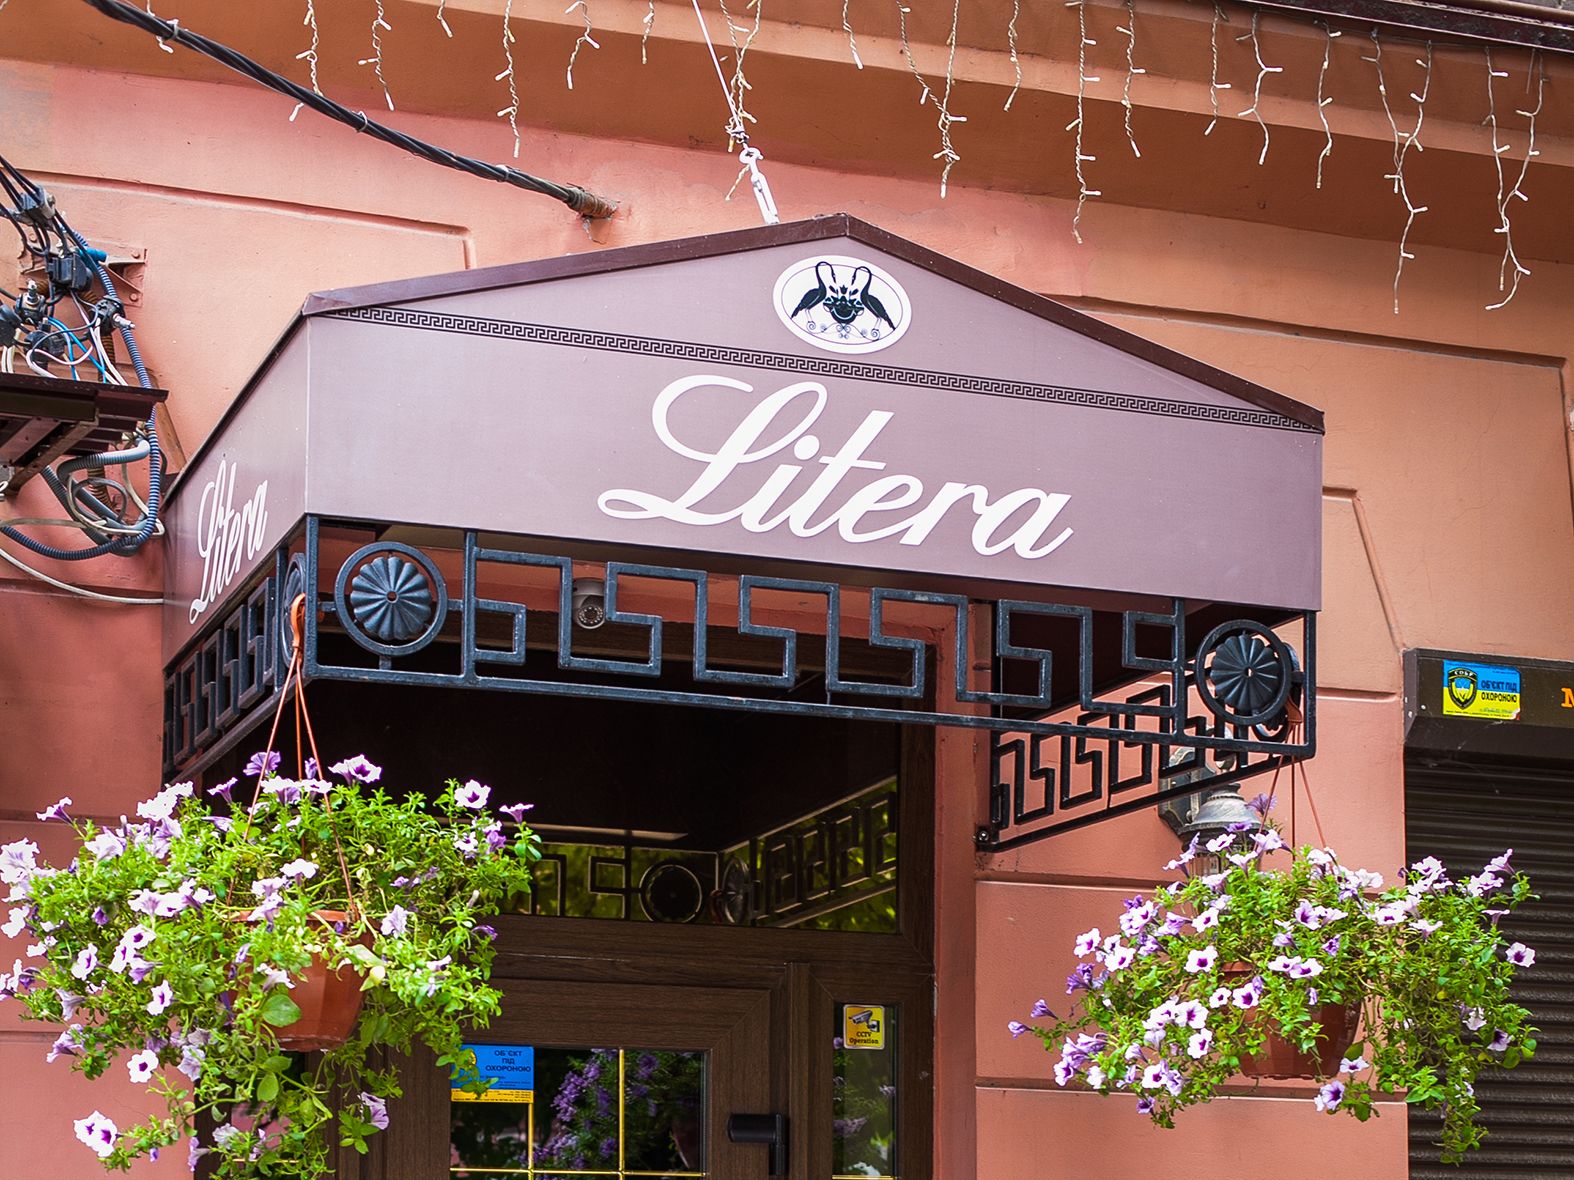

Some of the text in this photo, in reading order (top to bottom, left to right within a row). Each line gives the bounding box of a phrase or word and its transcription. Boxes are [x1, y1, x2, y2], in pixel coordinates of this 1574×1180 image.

[189, 459, 269, 624] Litera
[597, 374, 1075, 559] Litera
[1481, 692, 1518, 703] ОХОРОНОЮ
